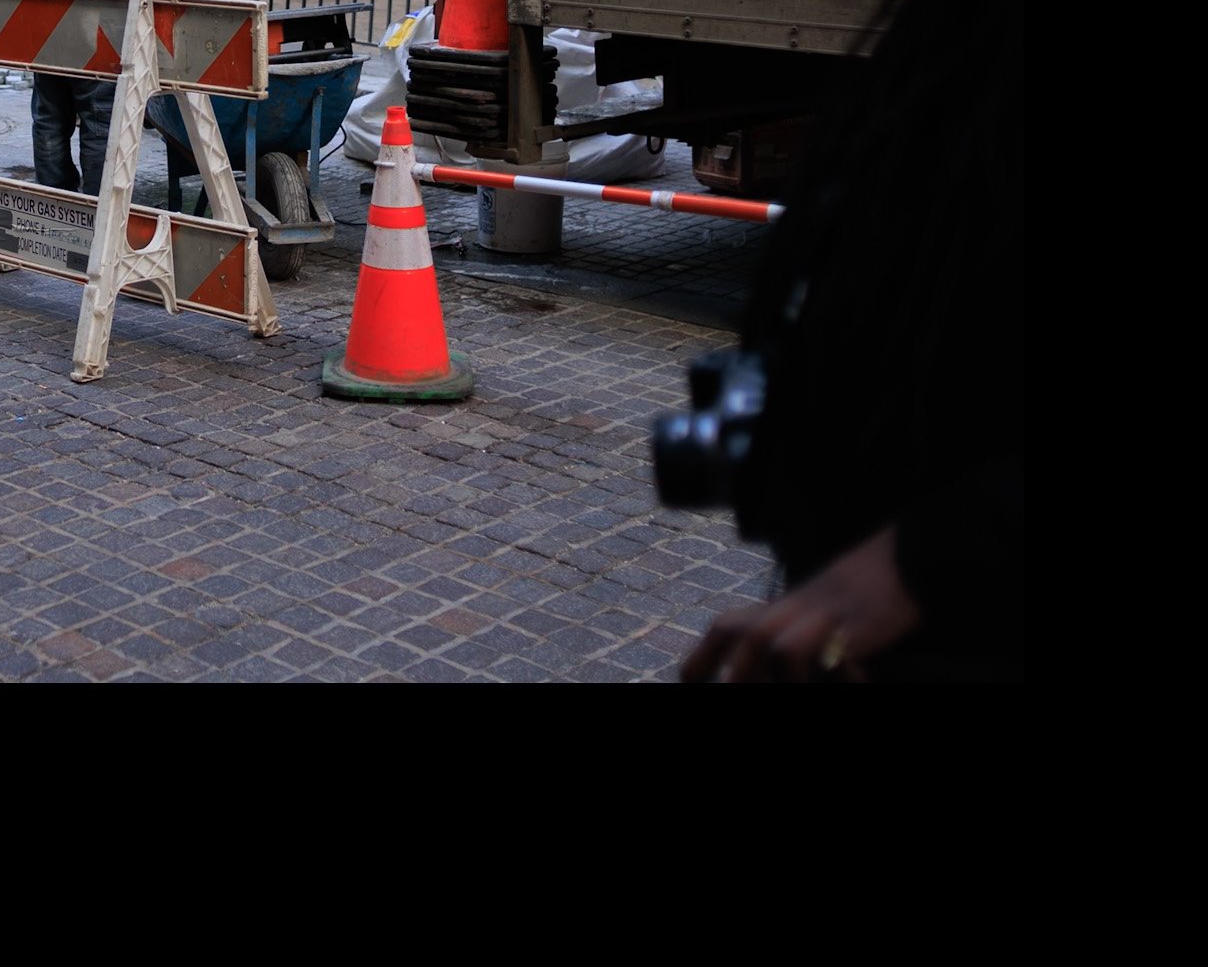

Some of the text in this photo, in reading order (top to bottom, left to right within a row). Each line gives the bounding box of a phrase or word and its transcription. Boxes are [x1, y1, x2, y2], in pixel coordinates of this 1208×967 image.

[11, 195, 35, 214] YOUR
[38, 202, 56, 218] GAS
[58, 207, 94, 228] SYSTEM
[17, 217, 39, 235] PHONE
[18, 237, 52, 259] OMPLETION
